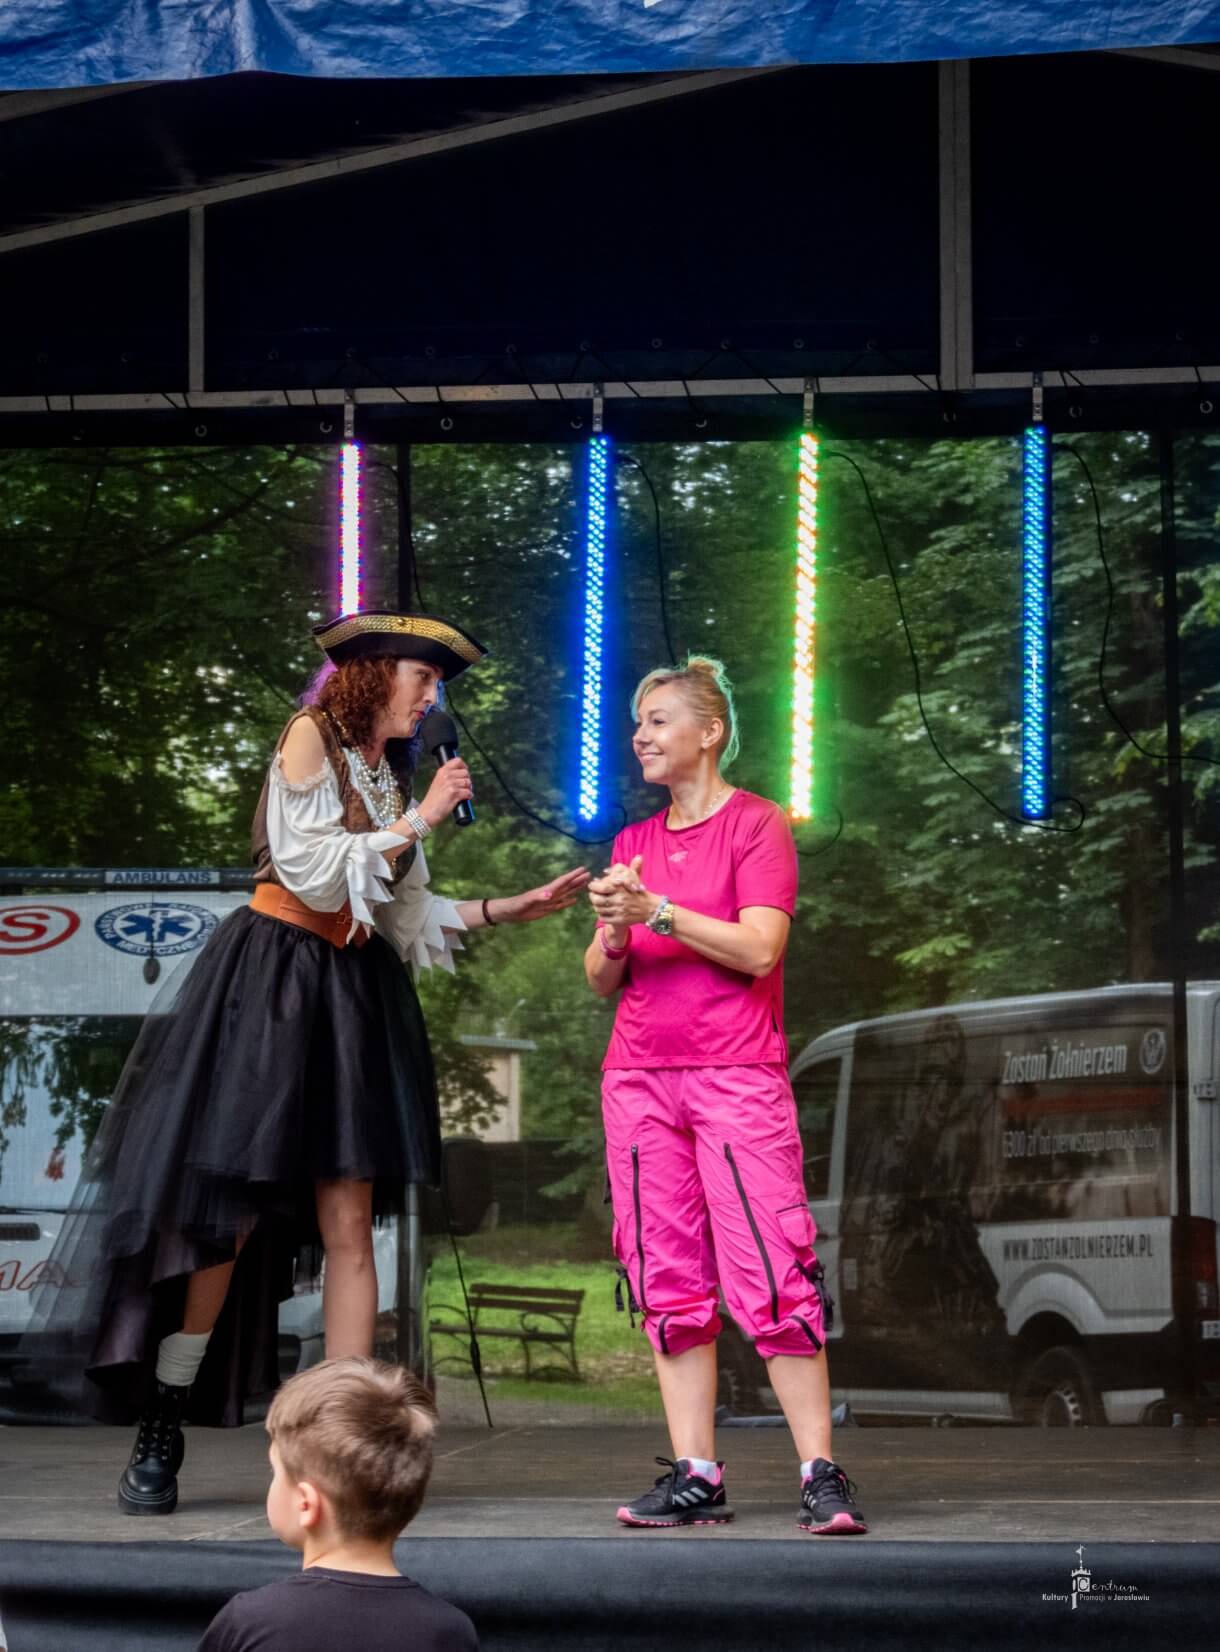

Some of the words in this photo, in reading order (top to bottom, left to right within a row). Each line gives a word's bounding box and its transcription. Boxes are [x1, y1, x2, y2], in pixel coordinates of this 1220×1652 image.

[112, 871, 211, 884] AMBULANS
[1002, 1046, 1049, 1085] Zostań
[1049, 1039, 1128, 1079] Żołnierzem
[1003, 1234, 1154, 1261] WWW.ZOSTANZOLNIERZEM.PL
